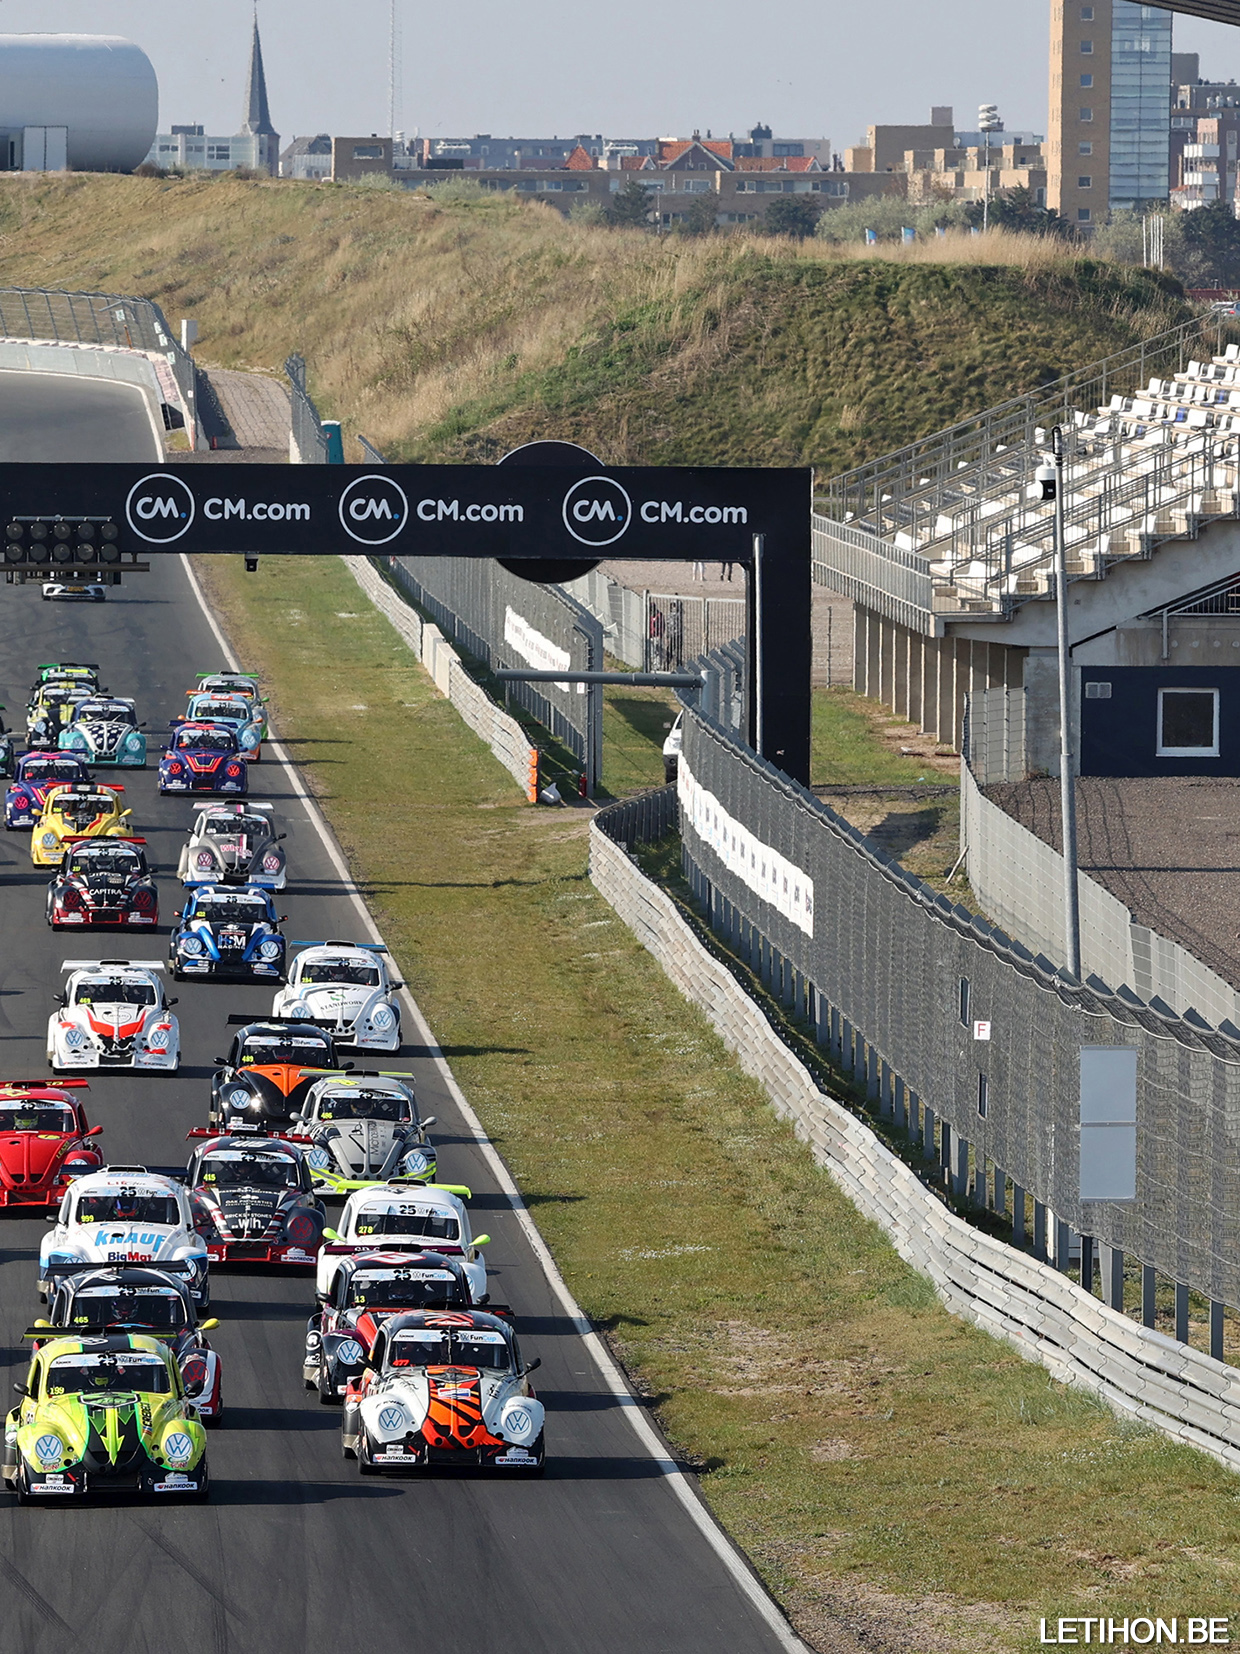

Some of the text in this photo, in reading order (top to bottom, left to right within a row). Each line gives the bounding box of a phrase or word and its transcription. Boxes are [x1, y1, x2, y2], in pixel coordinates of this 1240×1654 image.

[203, 497, 311, 521] CM.com
[416, 498, 525, 522] CM.com
[640, 500, 748, 523] CM.com
[89, 888, 122, 896] CAPITRA
[109, 976, 122, 985] 25
[977, 1023, 986, 1036] F
[120, 1186, 136, 1196] 25
[399, 1204, 417, 1215] 25
[358, 1226, 374, 1234] 278
[95, 1230, 167, 1252] KNAUF
[108, 1251, 152, 1262] BigMat
[393, 1269, 411, 1281] 25
[354, 1295, 366, 1303] 13
[470, 1334, 497, 1342] FunCup
[128, 1356, 157, 1364] FunCup
[49, 1387, 64, 1395] 199
